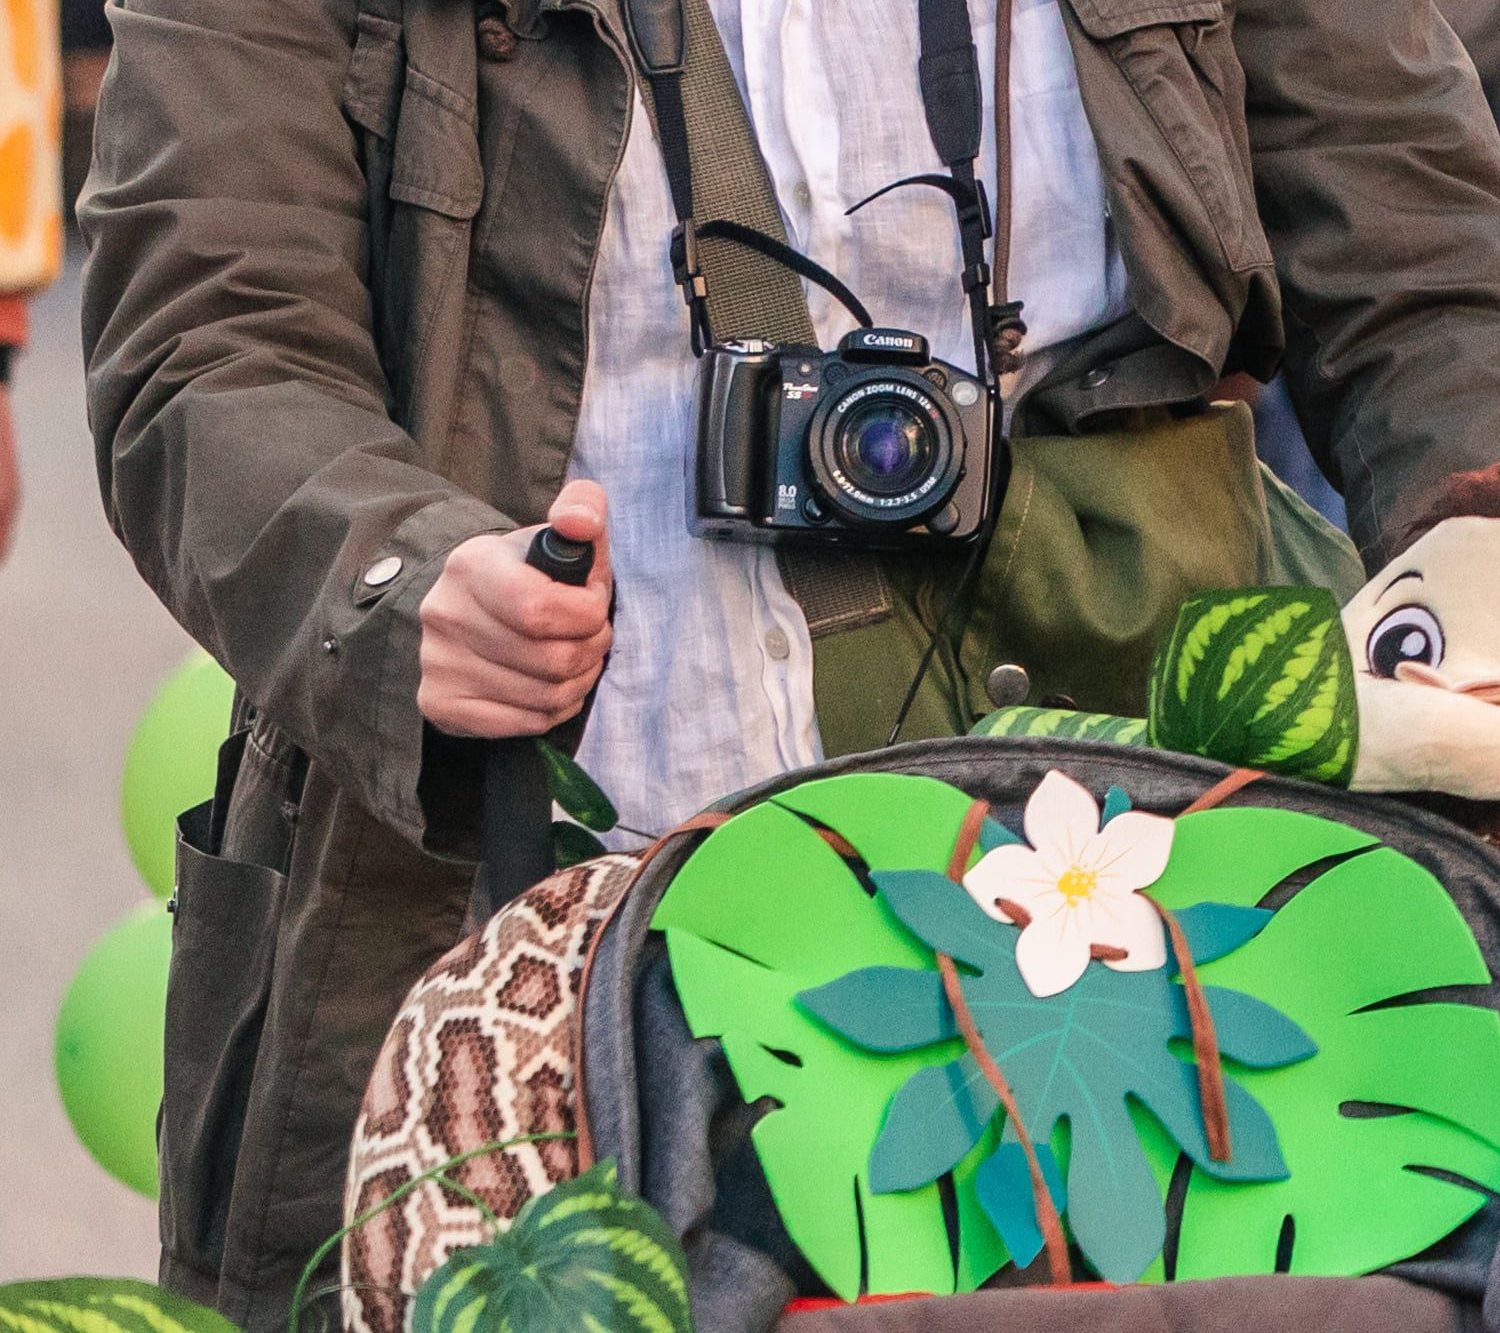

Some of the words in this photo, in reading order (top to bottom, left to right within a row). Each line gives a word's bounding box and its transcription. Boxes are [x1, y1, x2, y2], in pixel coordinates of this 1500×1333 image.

[863, 334, 913, 349] Canon
[837, 389, 865, 413] CANON
[866, 384, 895, 395] ZOOM
[896, 385, 918, 400] LENS
[778, 484, 797, 498] 8.0
